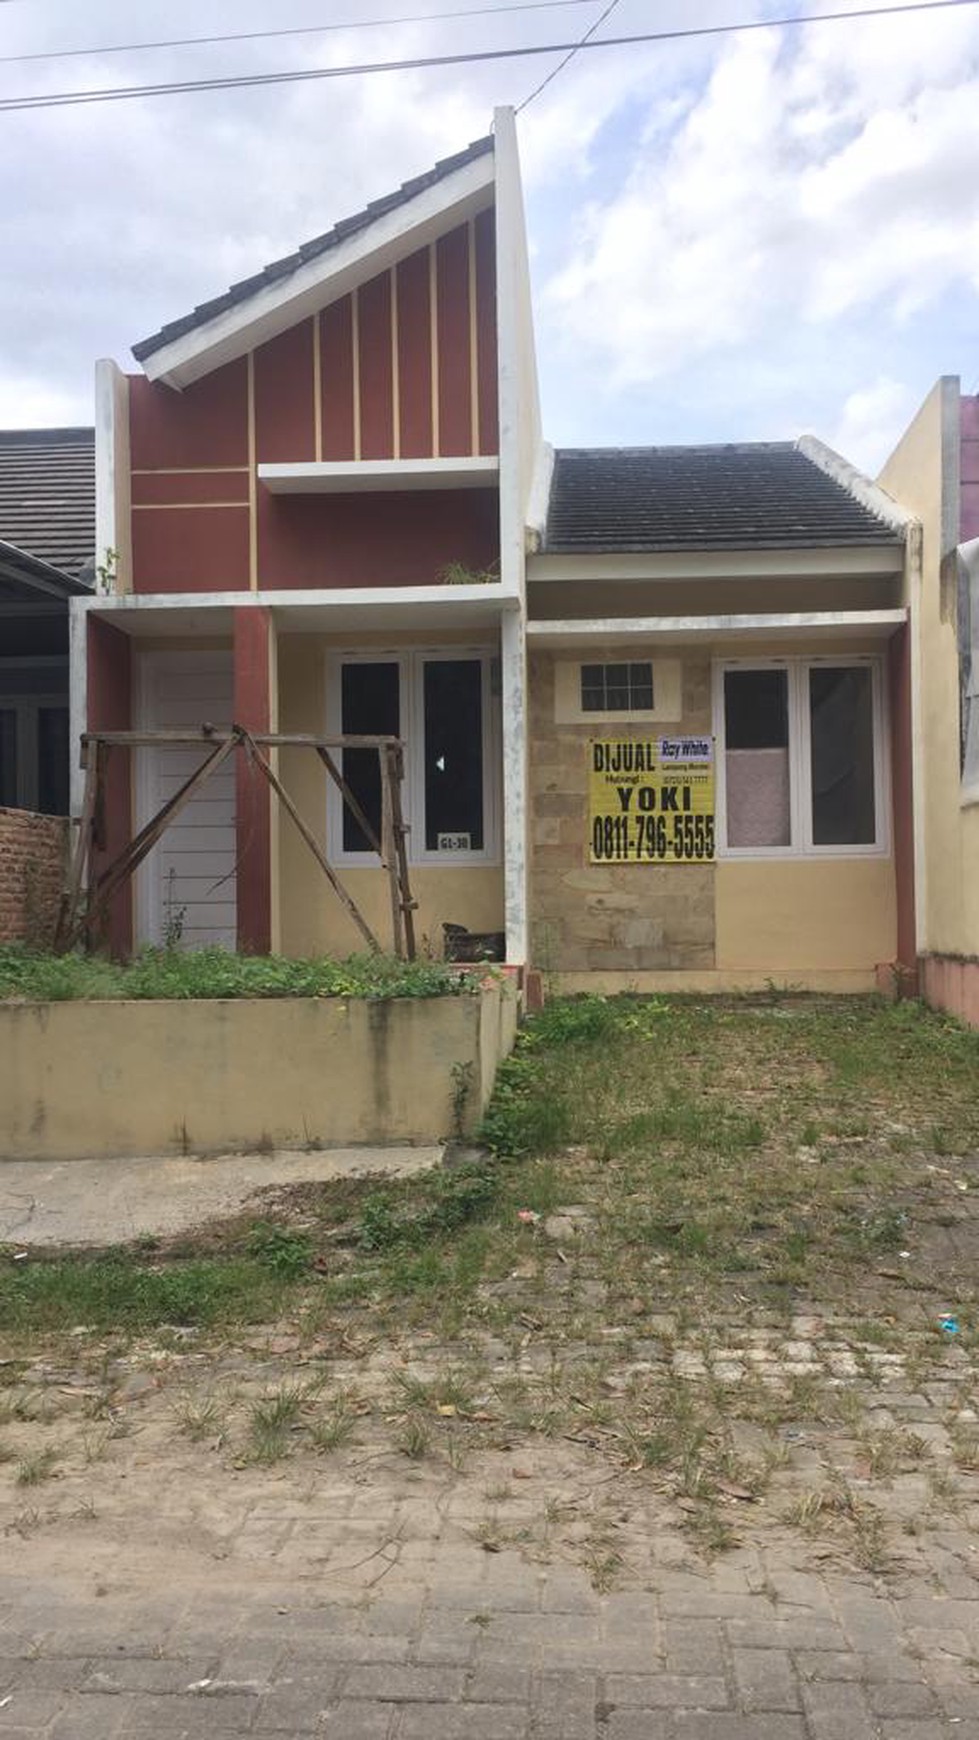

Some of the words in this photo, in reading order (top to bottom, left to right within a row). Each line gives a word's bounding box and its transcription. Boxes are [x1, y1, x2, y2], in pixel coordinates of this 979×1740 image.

[593, 743, 656, 772] DIJUAL
[662, 740, 680, 759] Ray
[681, 740, 709, 756] White
[616, 786, 691, 812] YOKI
[593, 815, 715, 859] 0811-796-5555
